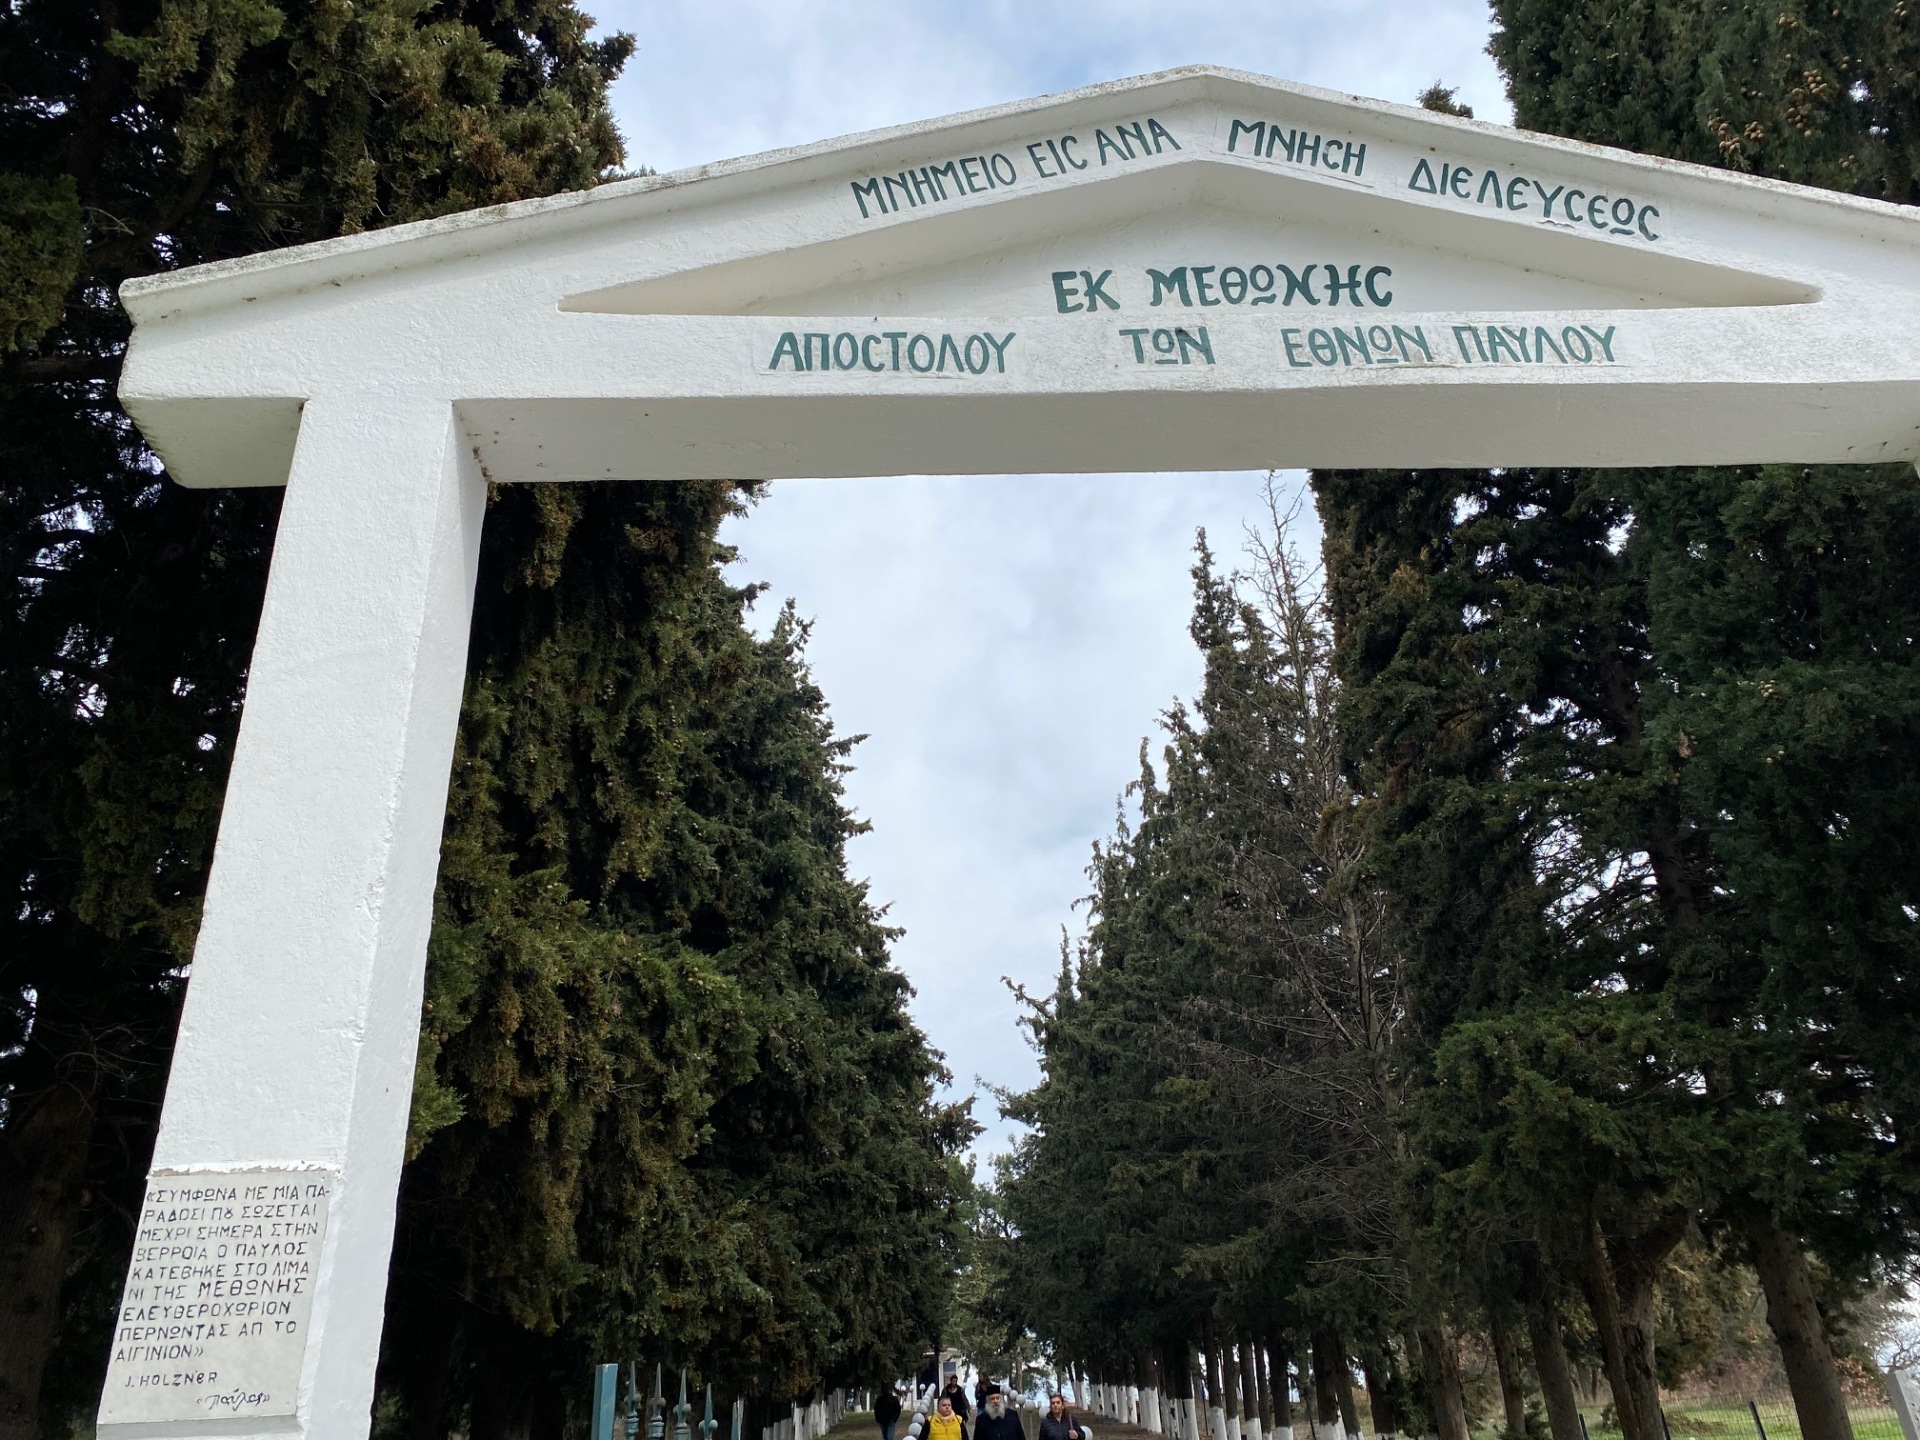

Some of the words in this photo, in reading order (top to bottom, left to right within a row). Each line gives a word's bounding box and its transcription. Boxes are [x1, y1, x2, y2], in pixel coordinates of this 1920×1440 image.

[851, 153, 1017, 218] ΜΝΗΜΕΙΟ
[1094, 118, 1182, 166] ΑΝΑ
[1052, 269, 1121, 314] ΕΚ
[1119, 325, 1216, 365] ΤΩΝ
[1281, 325, 1434, 368] ΕΘΝΩΝ
[1452, 325, 1615, 364] ΠΑΥΛΟΥ
[244, 1185, 268, 1200] ΜΕ
[273, 1185, 299, 1200] ΜΙΑ
[142, 1207, 206, 1224] ΡΑΔΟΣΙ
[241, 1203, 317, 1219] ΣΩΖΕΤΑΙ
[139, 1227, 191, 1242] ΜΕΧΡΙ
[197, 1224, 262, 1240] ΣΗΜΕΡΑ
[271, 1222, 318, 1237] ΣΤΗΝ
[135, 1245, 207, 1262] ΒΕΡΡΟΙΑ
[235, 1241, 308, 1258] ΠΑΥΛΟΣ
[131, 1264, 227, 1281] ΚΑΤΕΒΗΚΕ
[128, 1287, 144, 1301] ΝΙ
[153, 1285, 187, 1300] ΤΗΣ
[197, 1278, 307, 1298] ΜΕΘΩΝΗΣ
[123, 1301, 291, 1322] ΕΛΕΥΘΕΡΟΧΩΡΙΟΝ
[119, 1323, 230, 1342] ΠΕΡΝΩΝΤΑΣ
[238, 1321, 263, 1337] ΑΠ
[274, 1320, 297, 1334] ΤΟ
